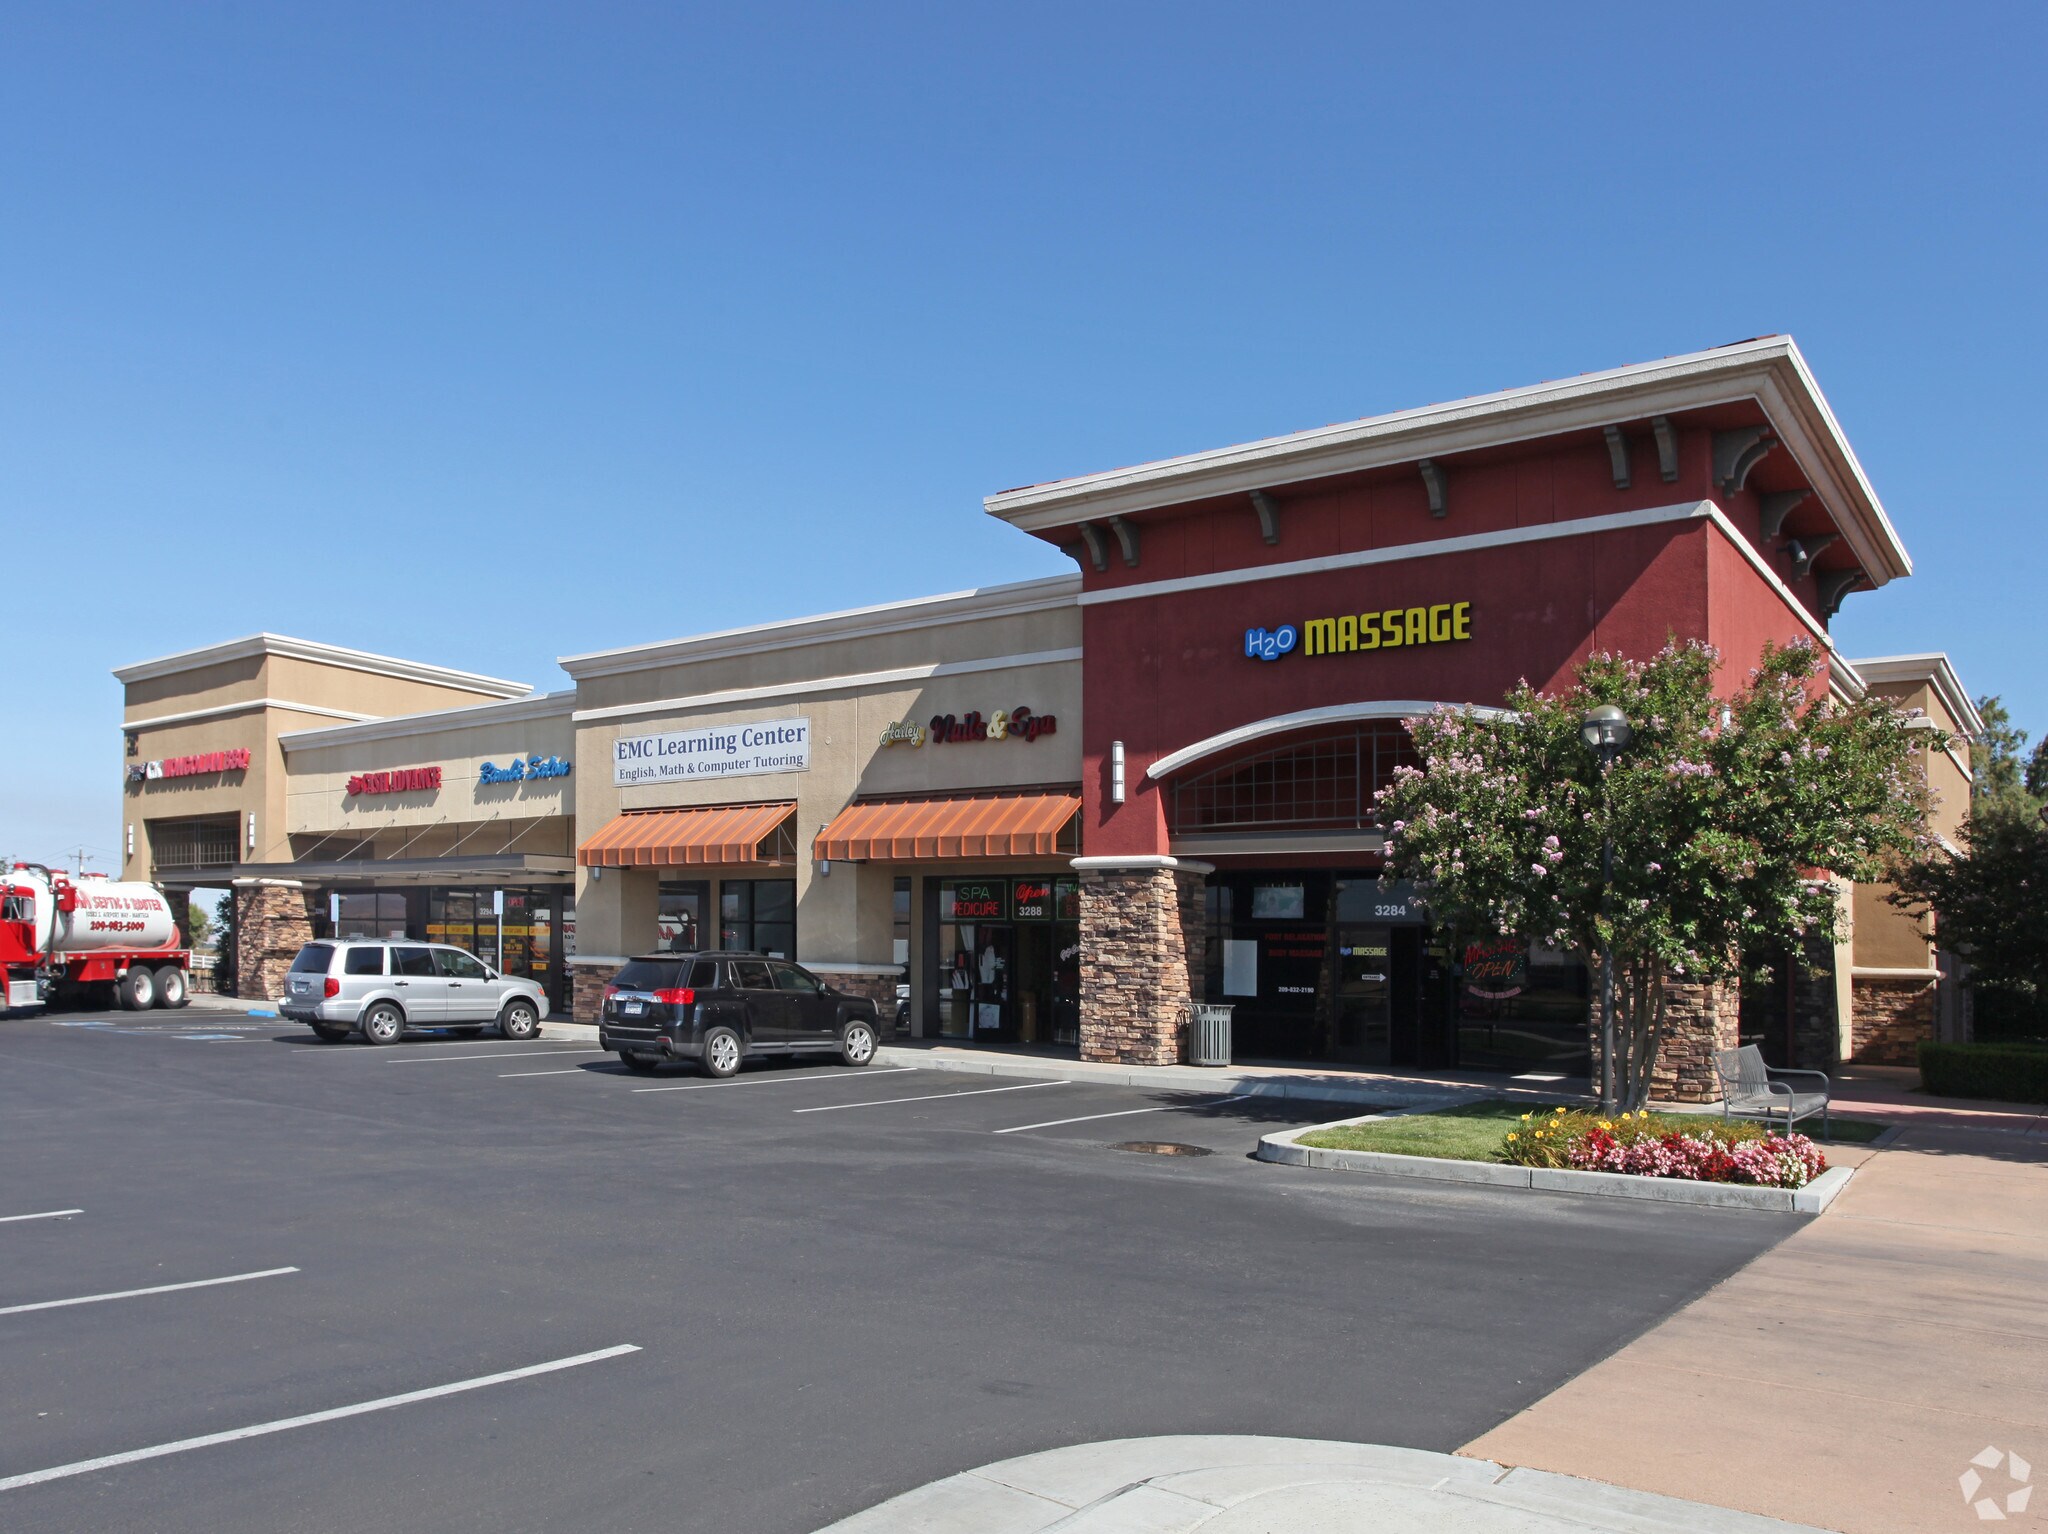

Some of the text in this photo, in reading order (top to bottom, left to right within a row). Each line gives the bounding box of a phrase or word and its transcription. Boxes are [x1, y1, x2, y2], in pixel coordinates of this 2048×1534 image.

[1247, 601, 1470, 658] H2O MASSAGE
[879, 706, 1057, 747] Hailey Nails & Spa
[618, 726, 806, 760] EMC Learning Center
[224, 747, 250, 769] BBQ
[619, 753, 804, 781] English, Math & Computer Tutoring
[525, 755, 571, 781] Salon
[363, 766, 442, 795] CASH ADVANCE
[960, 886, 990, 900] SPA
[1016, 883, 1050, 903] Open
[93, 896, 122, 909] SEPTIC
[130, 898, 163, 911] ROOTER
[952, 901, 999, 916] PEDICURE
[1019, 906, 1042, 916] 3288
[1375, 905, 1406, 916] 3284
[90, 921, 145, 932] 209-983-5009
[1352, 947, 1388, 956] MASSAGE
[1472, 960, 1516, 979] OPEN
